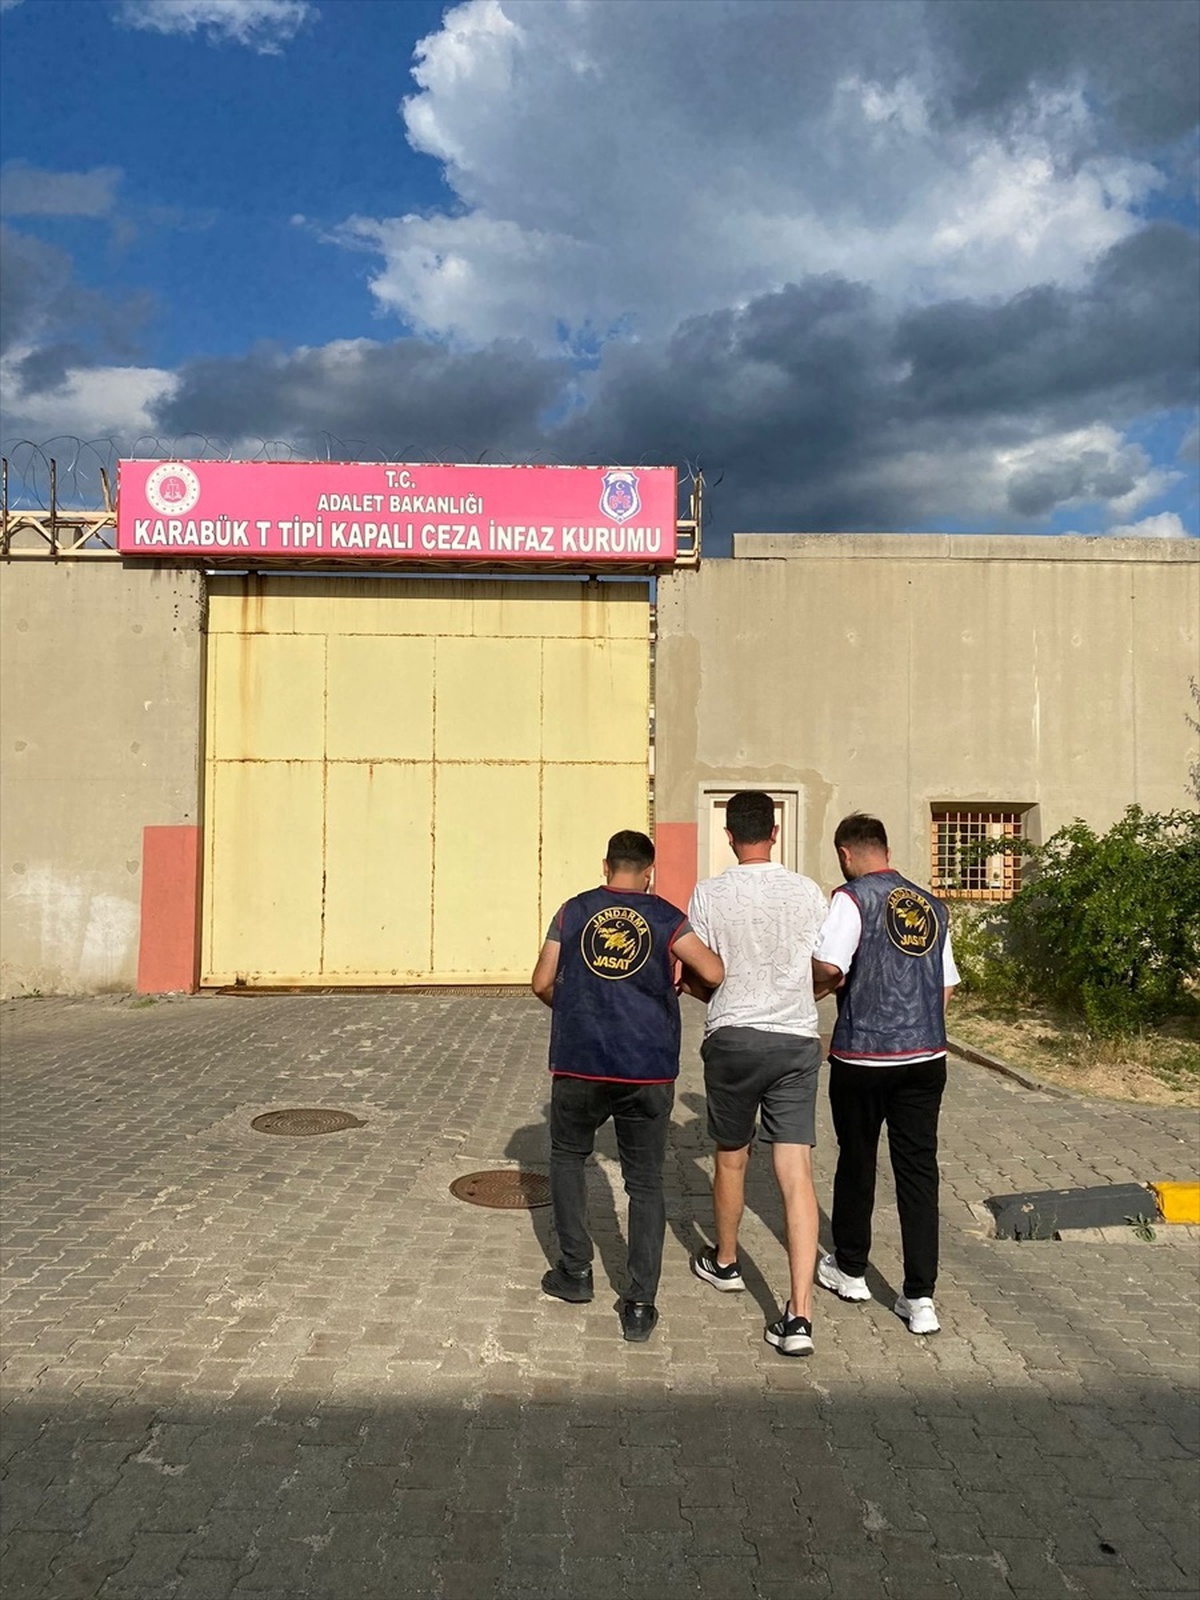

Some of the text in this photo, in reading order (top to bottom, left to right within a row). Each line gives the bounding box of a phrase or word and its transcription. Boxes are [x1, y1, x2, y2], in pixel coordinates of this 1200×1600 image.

[385, 470, 416, 488] T.C.
[317, 493, 483, 514] ADALET BAKANLIĞI
[134, 515, 661, 552] KARABÜK T TİPİ KAPALI CEZA İNFAZ KURUMU
[593, 909, 648, 936] JANDARMA
[593, 955, 631, 970] JASAT
